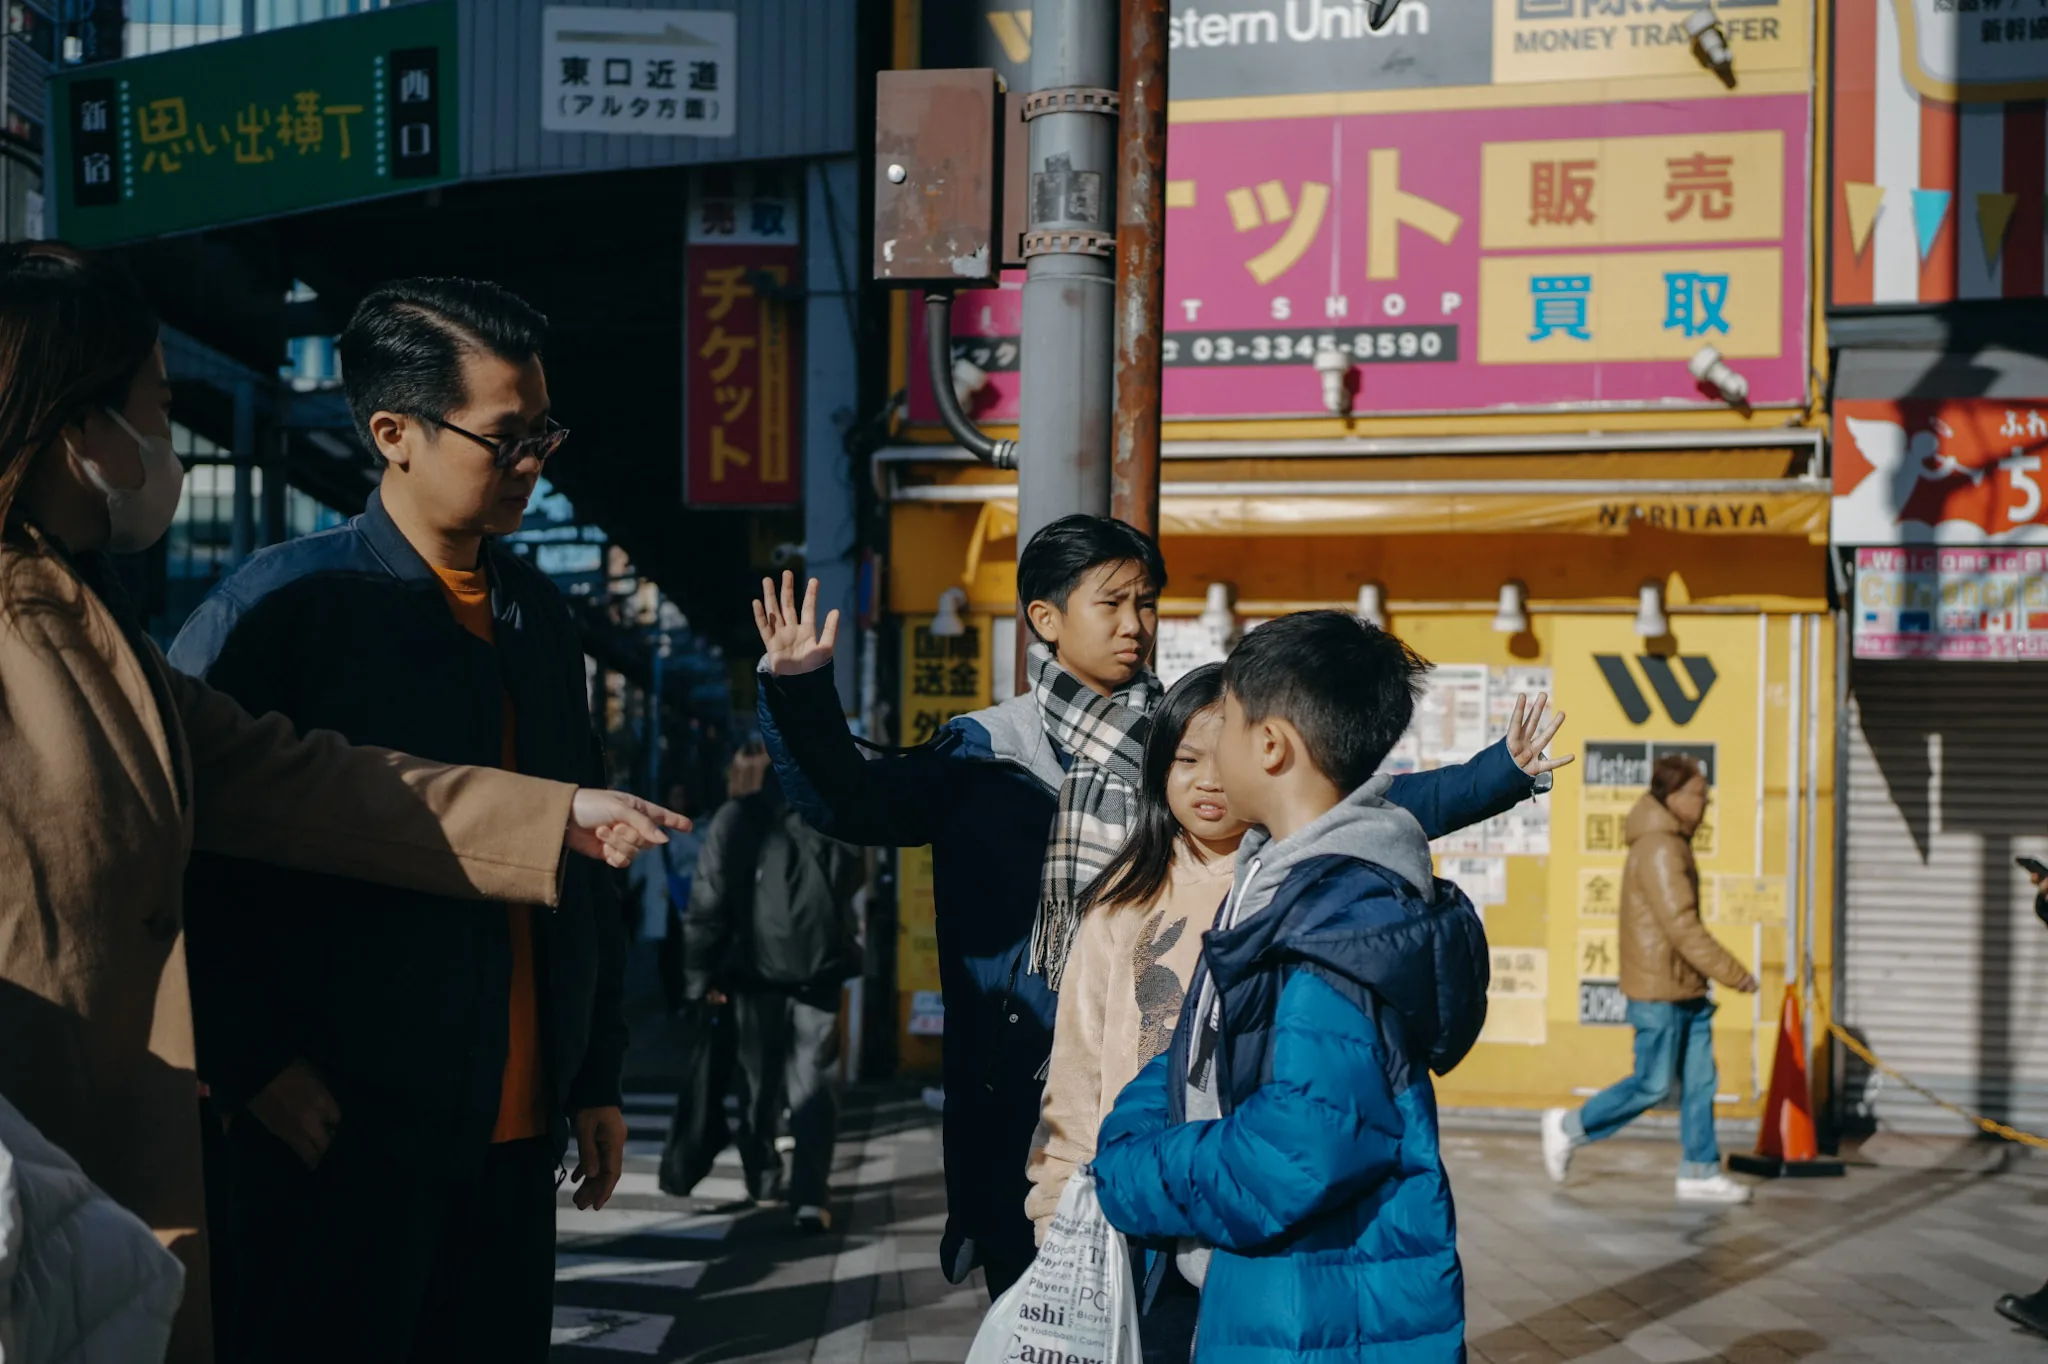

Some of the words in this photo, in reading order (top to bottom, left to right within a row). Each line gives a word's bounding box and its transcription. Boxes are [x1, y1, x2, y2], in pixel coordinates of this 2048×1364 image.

[1168, 8, 1278, 49] stern
[1512, 26, 1617, 53] MONEY
[1624, 17, 1778, 47] TRAFER
[560, 57, 720, 92] 東口近道
[138, 91, 364, 173] 思い出横丁
[401, 69, 431, 157] 西口
[81, 100, 111, 185] 新宿
[1167, 148, 1463, 285] ット
[1528, 151, 1735, 227] 販売
[1270, 292, 1462, 320] SHOP
[1527, 270, 1732, 342] 買取
[699, 264, 757, 483] チケット
[1191, 331, 1442, 362] 03-3345-8590
[1598, 503, 1767, 528] NARITAYA
[1029, 1277, 1070, 1294] Players
